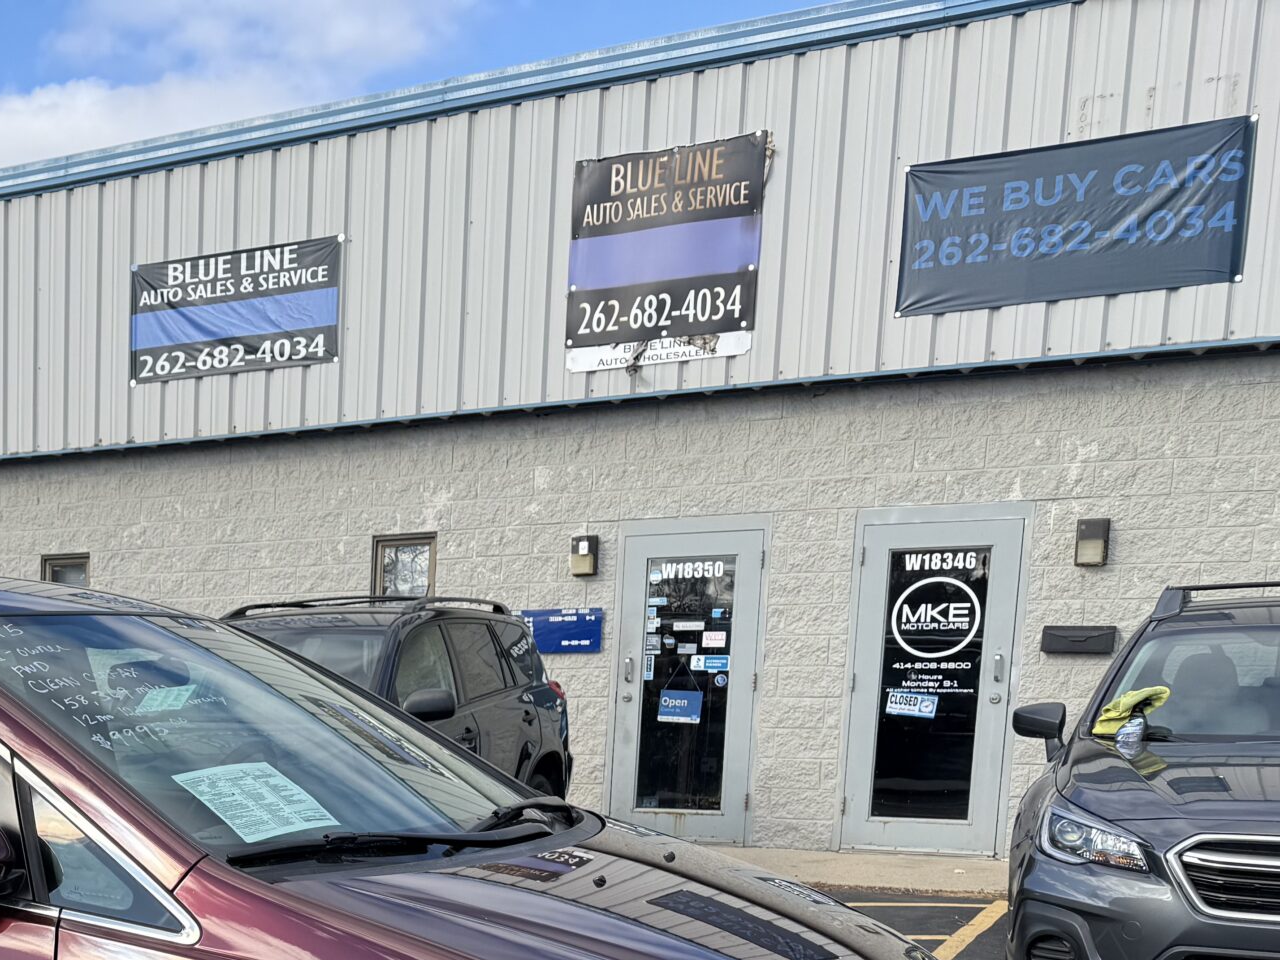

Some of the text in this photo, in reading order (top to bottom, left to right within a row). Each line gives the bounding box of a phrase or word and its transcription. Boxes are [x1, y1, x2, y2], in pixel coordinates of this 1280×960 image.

[610, 146, 726, 197] BLUE LINE
[915, 150, 1246, 222] WE BUY CARS
[582, 181, 750, 226] AUTO SALES & SERVICE
[911, 200, 1238, 270] 262-682-4034
[167, 245, 298, 286] BLUE LINE
[139, 265, 328, 307] AUTO SALES & SERVICE
[577, 285, 742, 334] 262-682-4034
[139, 334, 325, 378] 262-682-4034
[623, 341, 658, 354] BE
[597, 356, 627, 368] AUTO
[661, 561, 724, 579] W18350
[905, 552, 977, 571] W18346
[901, 602, 971, 623] MKE
[940, 622, 969, 630] CARS
[902, 680, 940, 688] Monday
[661, 697, 688, 708] Open
[889, 694, 919, 707] CLOSED
